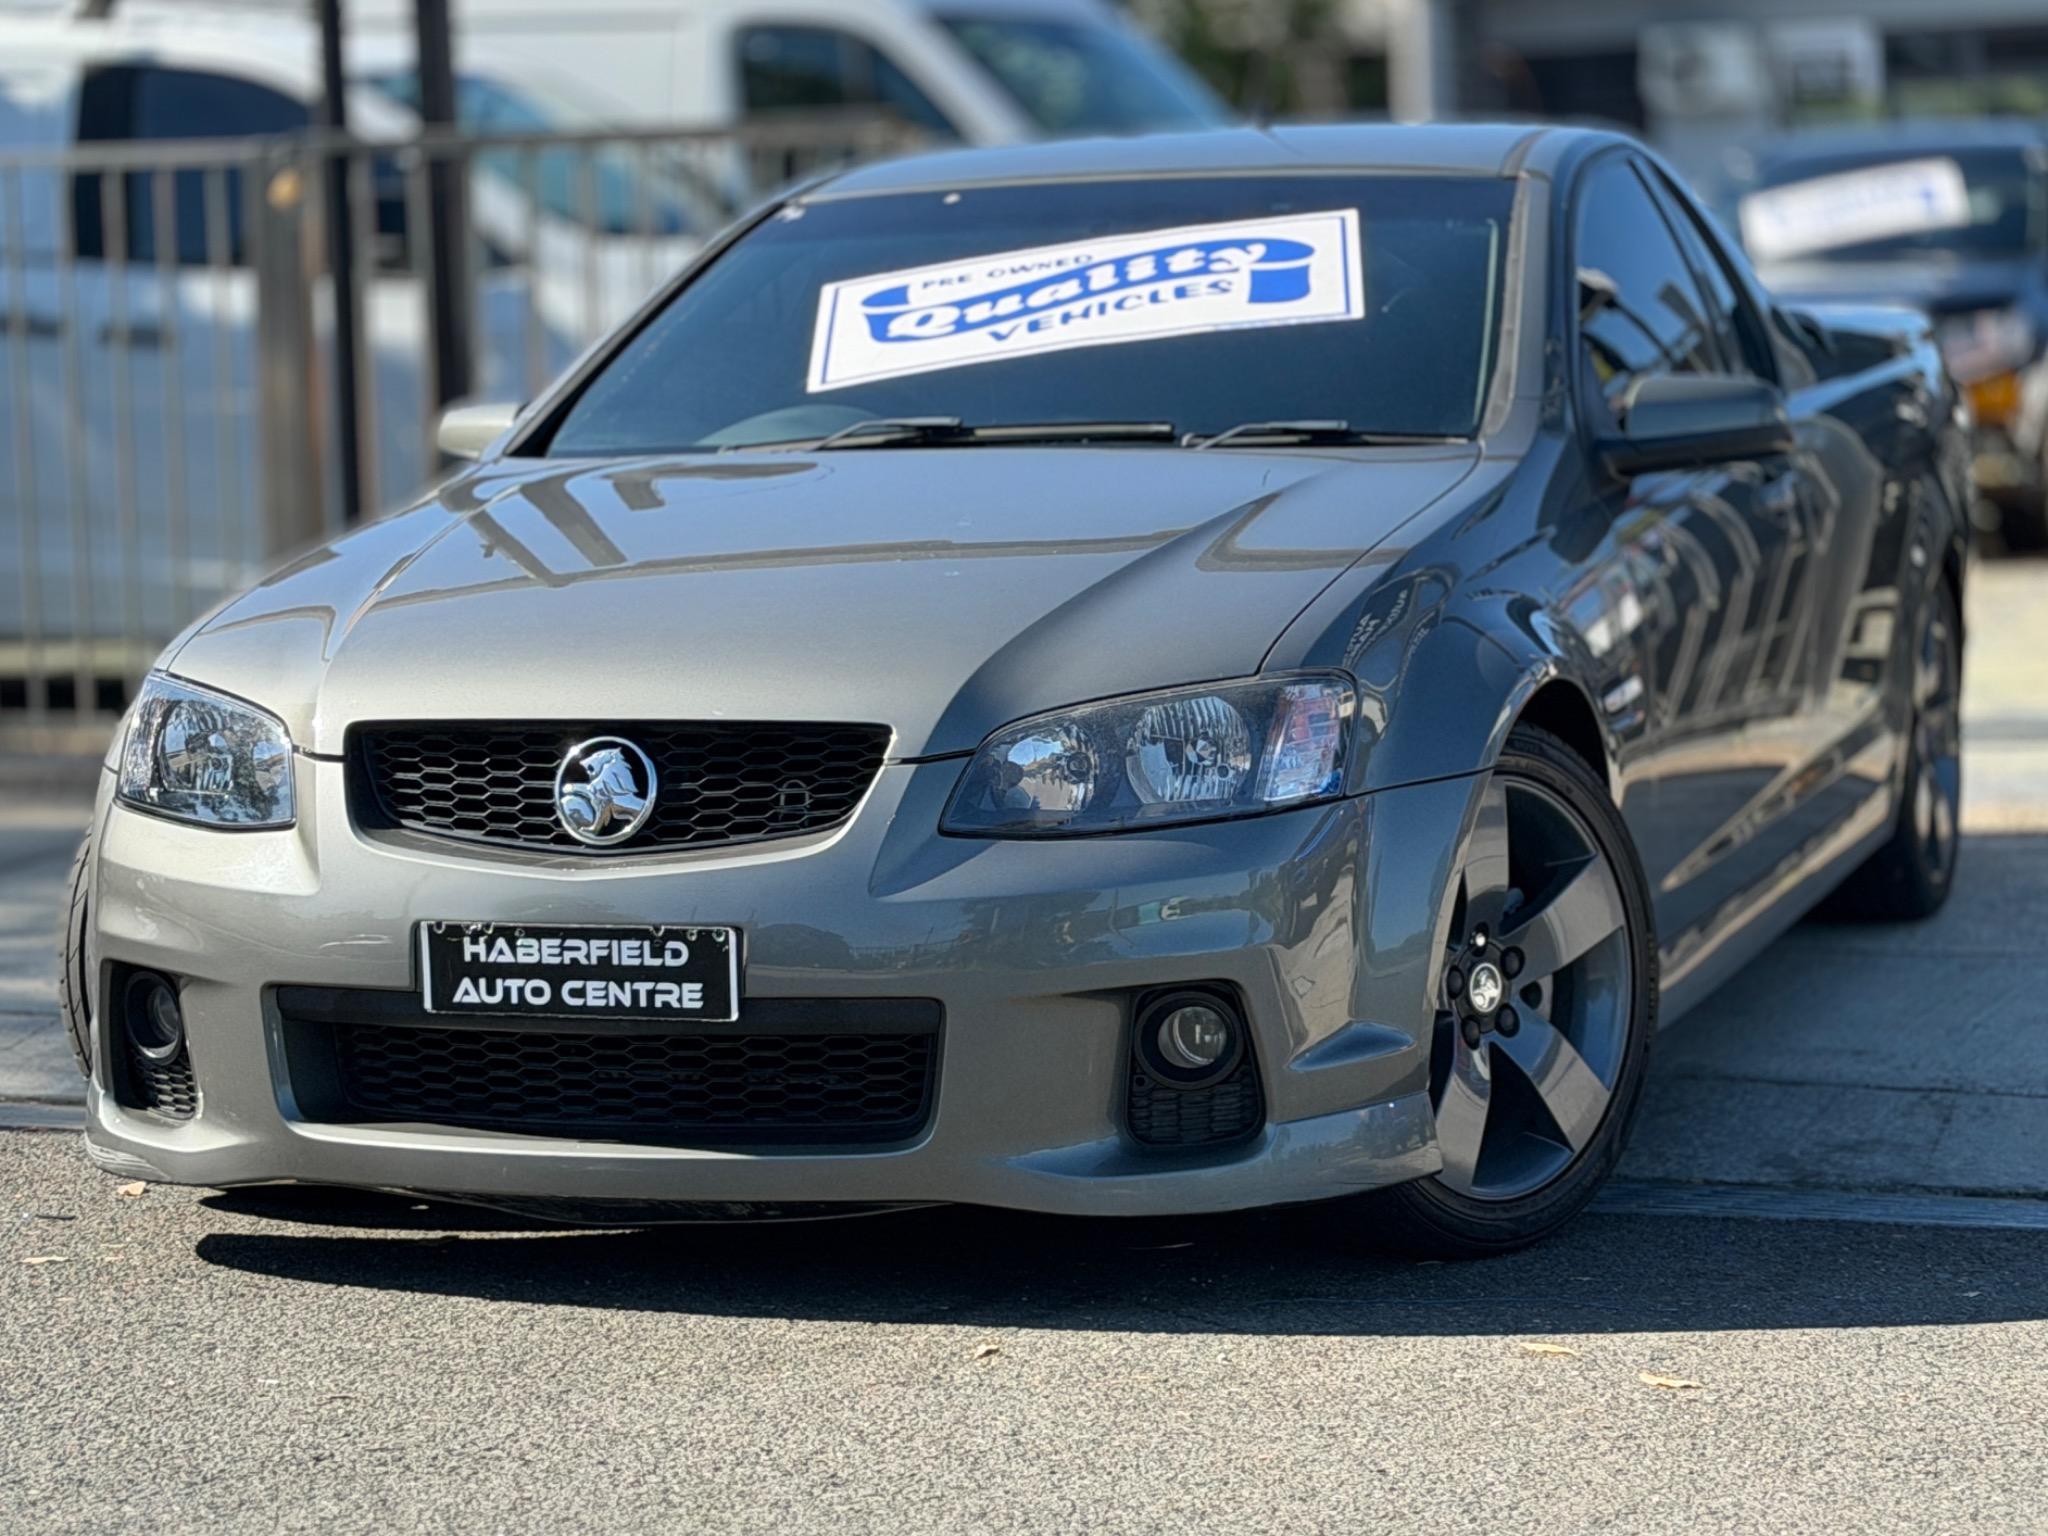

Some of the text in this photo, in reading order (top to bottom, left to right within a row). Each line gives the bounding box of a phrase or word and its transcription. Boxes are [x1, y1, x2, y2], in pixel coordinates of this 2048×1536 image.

[921, 253, 1093, 290] PRE OWNED
[886, 243, 1268, 339] Quality
[985, 278, 1235, 342] VEHICLES
[463, 936, 690, 967] HABERFIELD
[452, 976, 705, 1009] AUTO CENTRE
